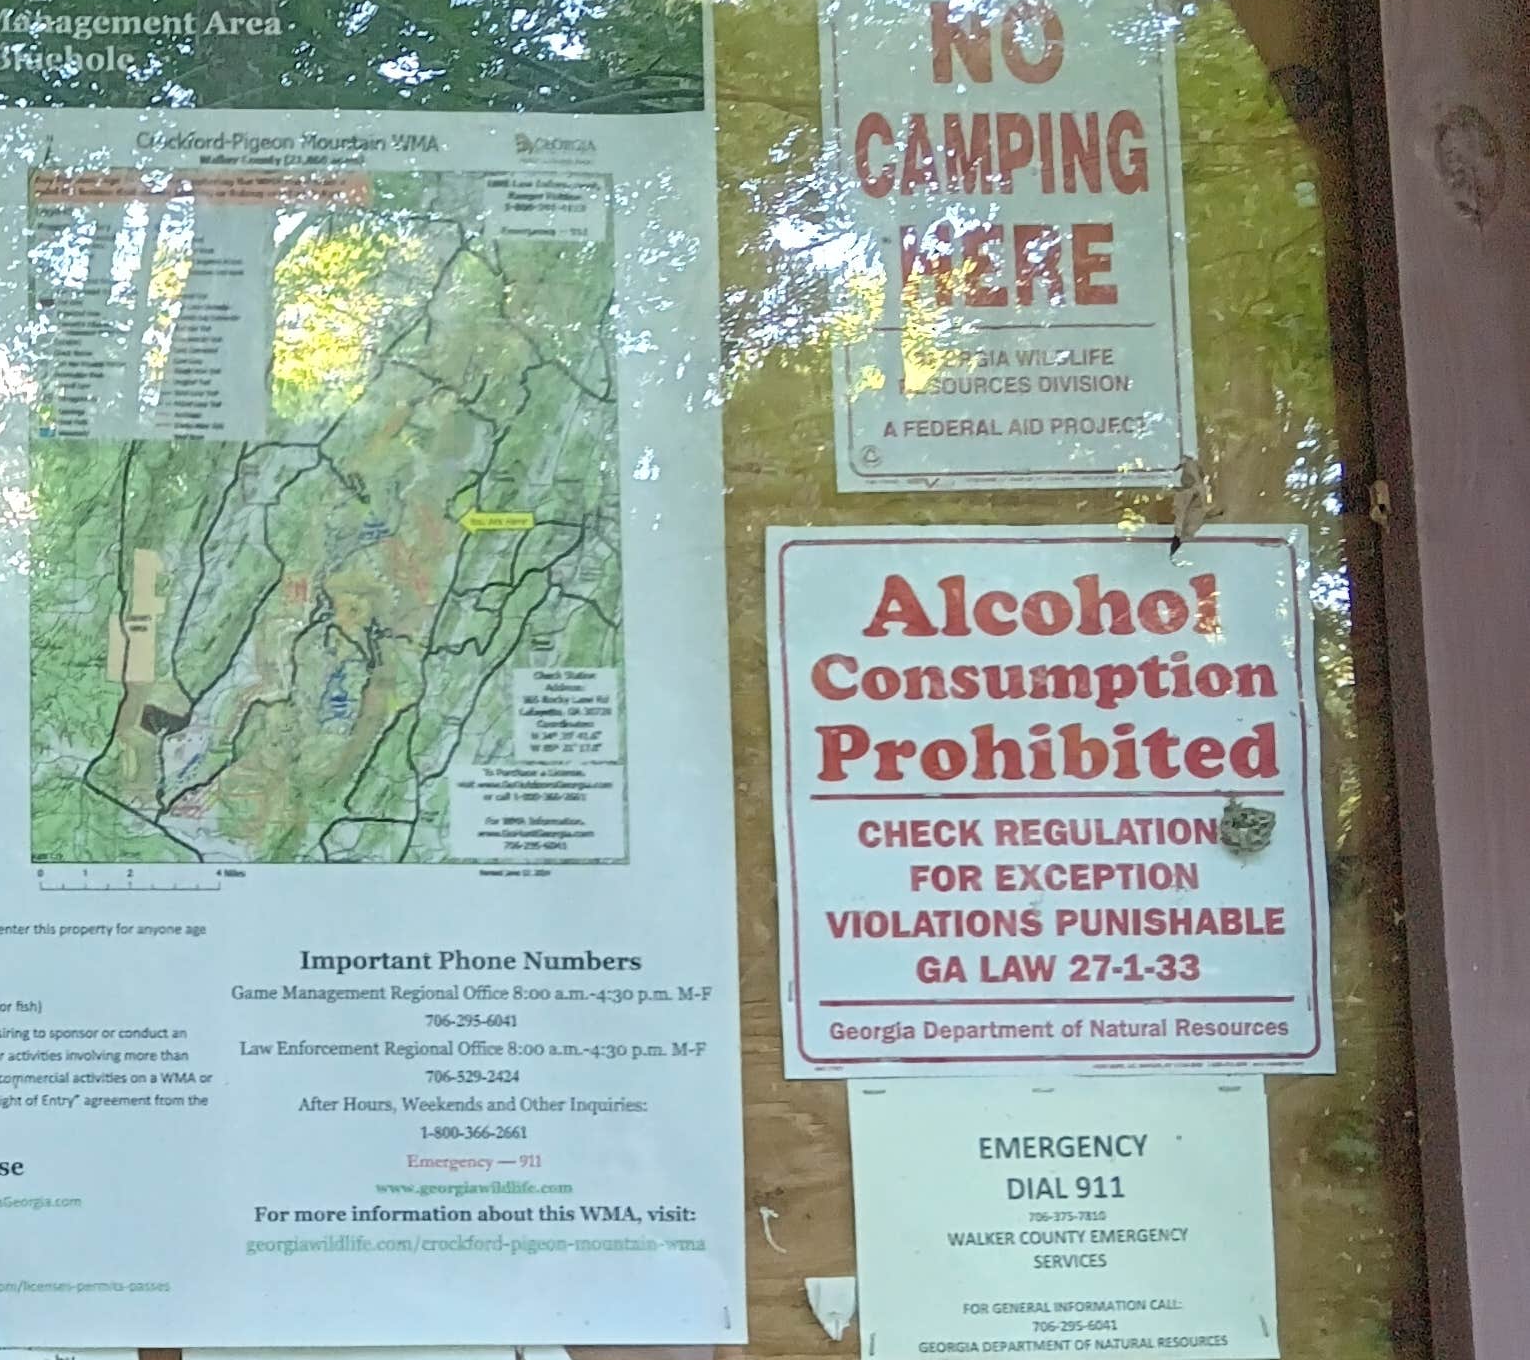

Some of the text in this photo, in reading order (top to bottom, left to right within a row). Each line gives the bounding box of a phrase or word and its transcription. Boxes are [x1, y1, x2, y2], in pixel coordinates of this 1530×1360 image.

[203, 9, 283, 35] Area
[930, 1, 1065, 85] NO
[855, 109, 1150, 198] CAMPING
[899, 223, 1118, 309] HERE
[1039, 376, 1129, 392] DIVISION
[884, 422, 897, 438] A
[904, 420, 1002, 436] FEDERAL
[1009, 419, 1043, 434] AID
[861, 572, 1221, 638] Alcohol
[811, 650, 1279, 710] Consumption
[814, 721, 1281, 782] Prohibited
[857, 819, 984, 849] CHECK
[910, 862, 1199, 893] FOR EXCEPTION
[825, 906, 1286, 939] VIOLATIONS PUNISHABLE
[300, 949, 642, 976] Important Phone Numbers
[916, 953, 1201, 985] GA LAW 27-1-33
[424, 1013, 518, 1028] 706-295-6041
[829, 1018, 1290, 1045] Georgia Department of Natural Resources
[424, 1069, 520, 1084] 706-529-2424
[419, 1125, 528, 1140] 1-800-366-2661
[979, 1133, 1148, 1160] EMERGENCY
[1006, 1175, 1126, 1200] DIAL 911
[947, 1227, 1189, 1247] WALKER COUNTY EMERGENCY
[1033, 1253, 1108, 1270] SERVICES
[962, 1298, 1183, 1316] FOR GENERAL INFORMATION CALL:
[1031, 1319, 1119, 1333] 706-295-6041
[917, 1334, 1229, 1354] GEORGIA DEPARTMENT OF NATURAL RESOURCES
